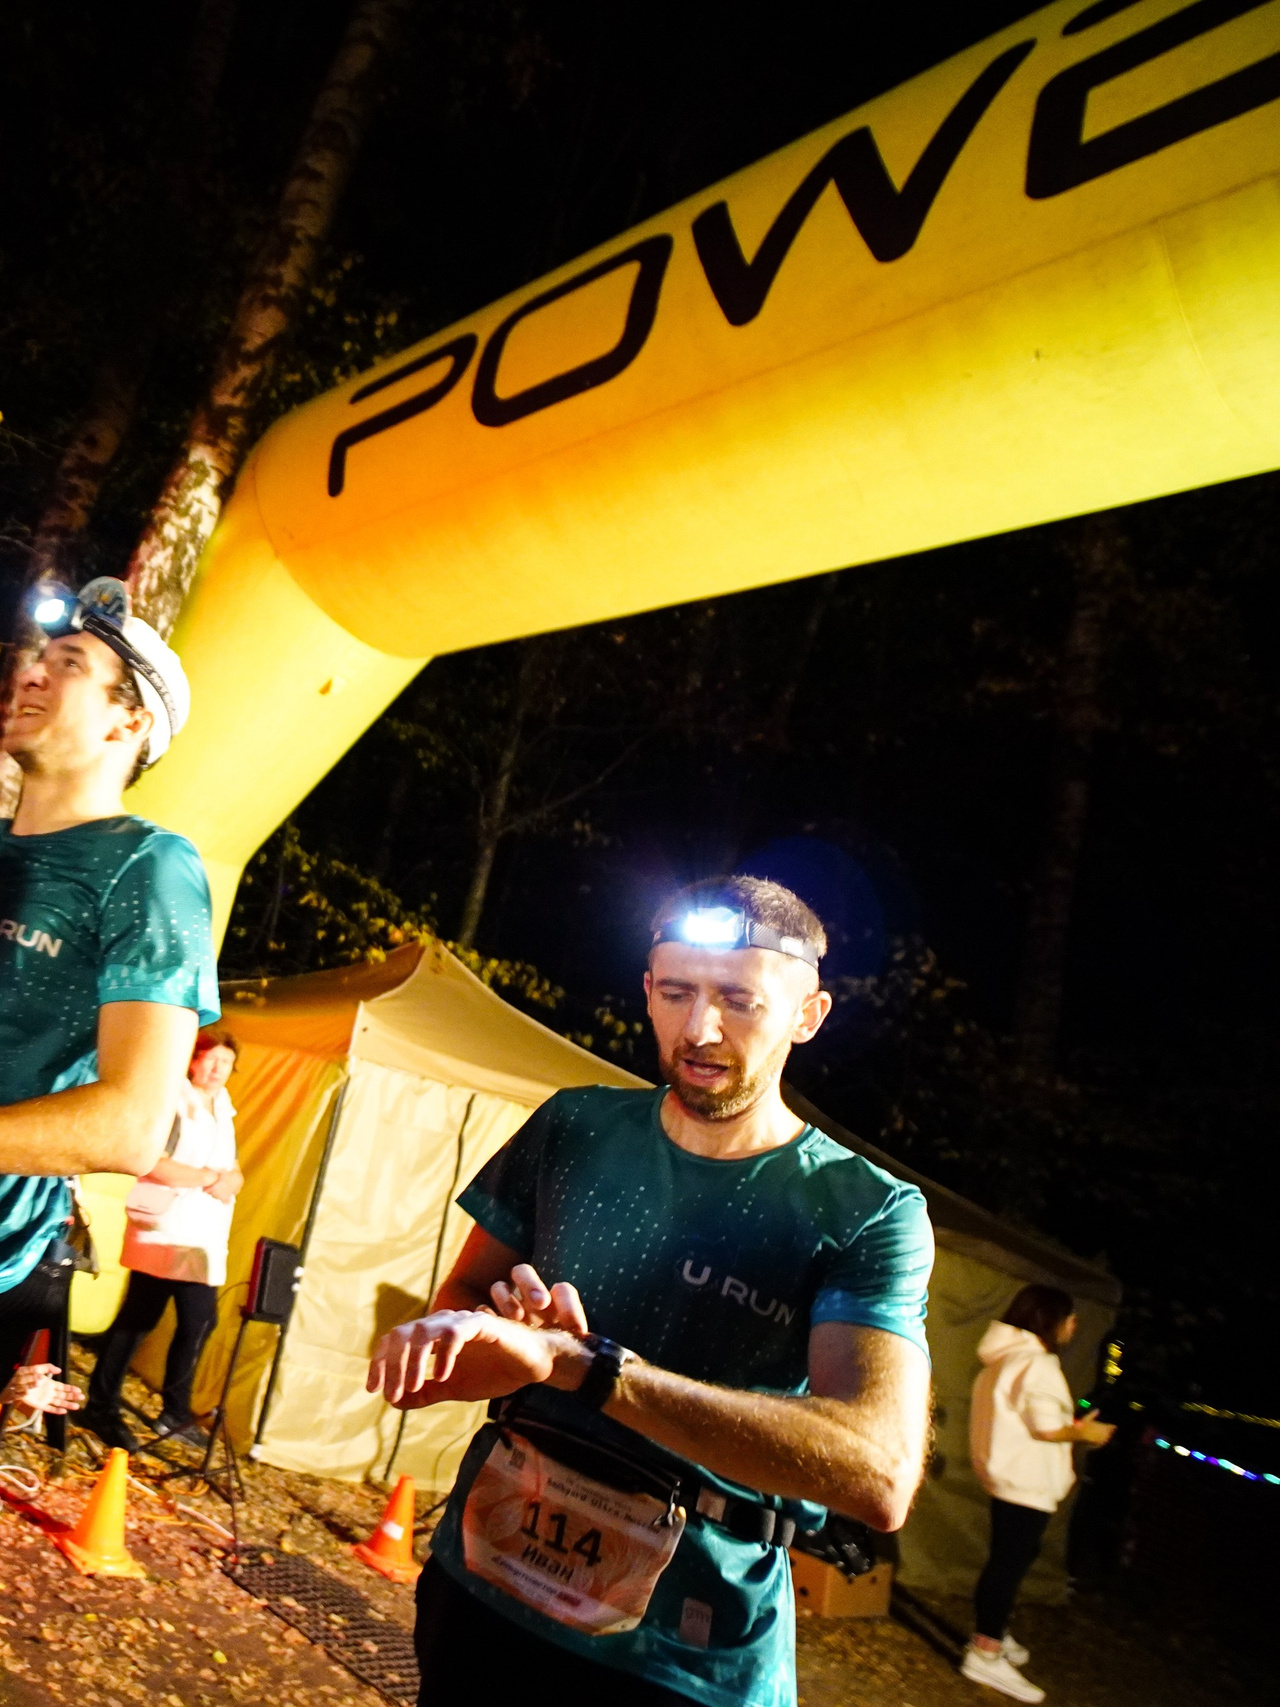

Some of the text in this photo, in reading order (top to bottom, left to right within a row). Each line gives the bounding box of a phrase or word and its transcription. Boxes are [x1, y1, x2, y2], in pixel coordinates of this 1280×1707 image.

[682, 1259, 796, 1326] U RUN
[521, 1502, 602, 1567] 114
[522, 1543, 575, 1581] Иван
